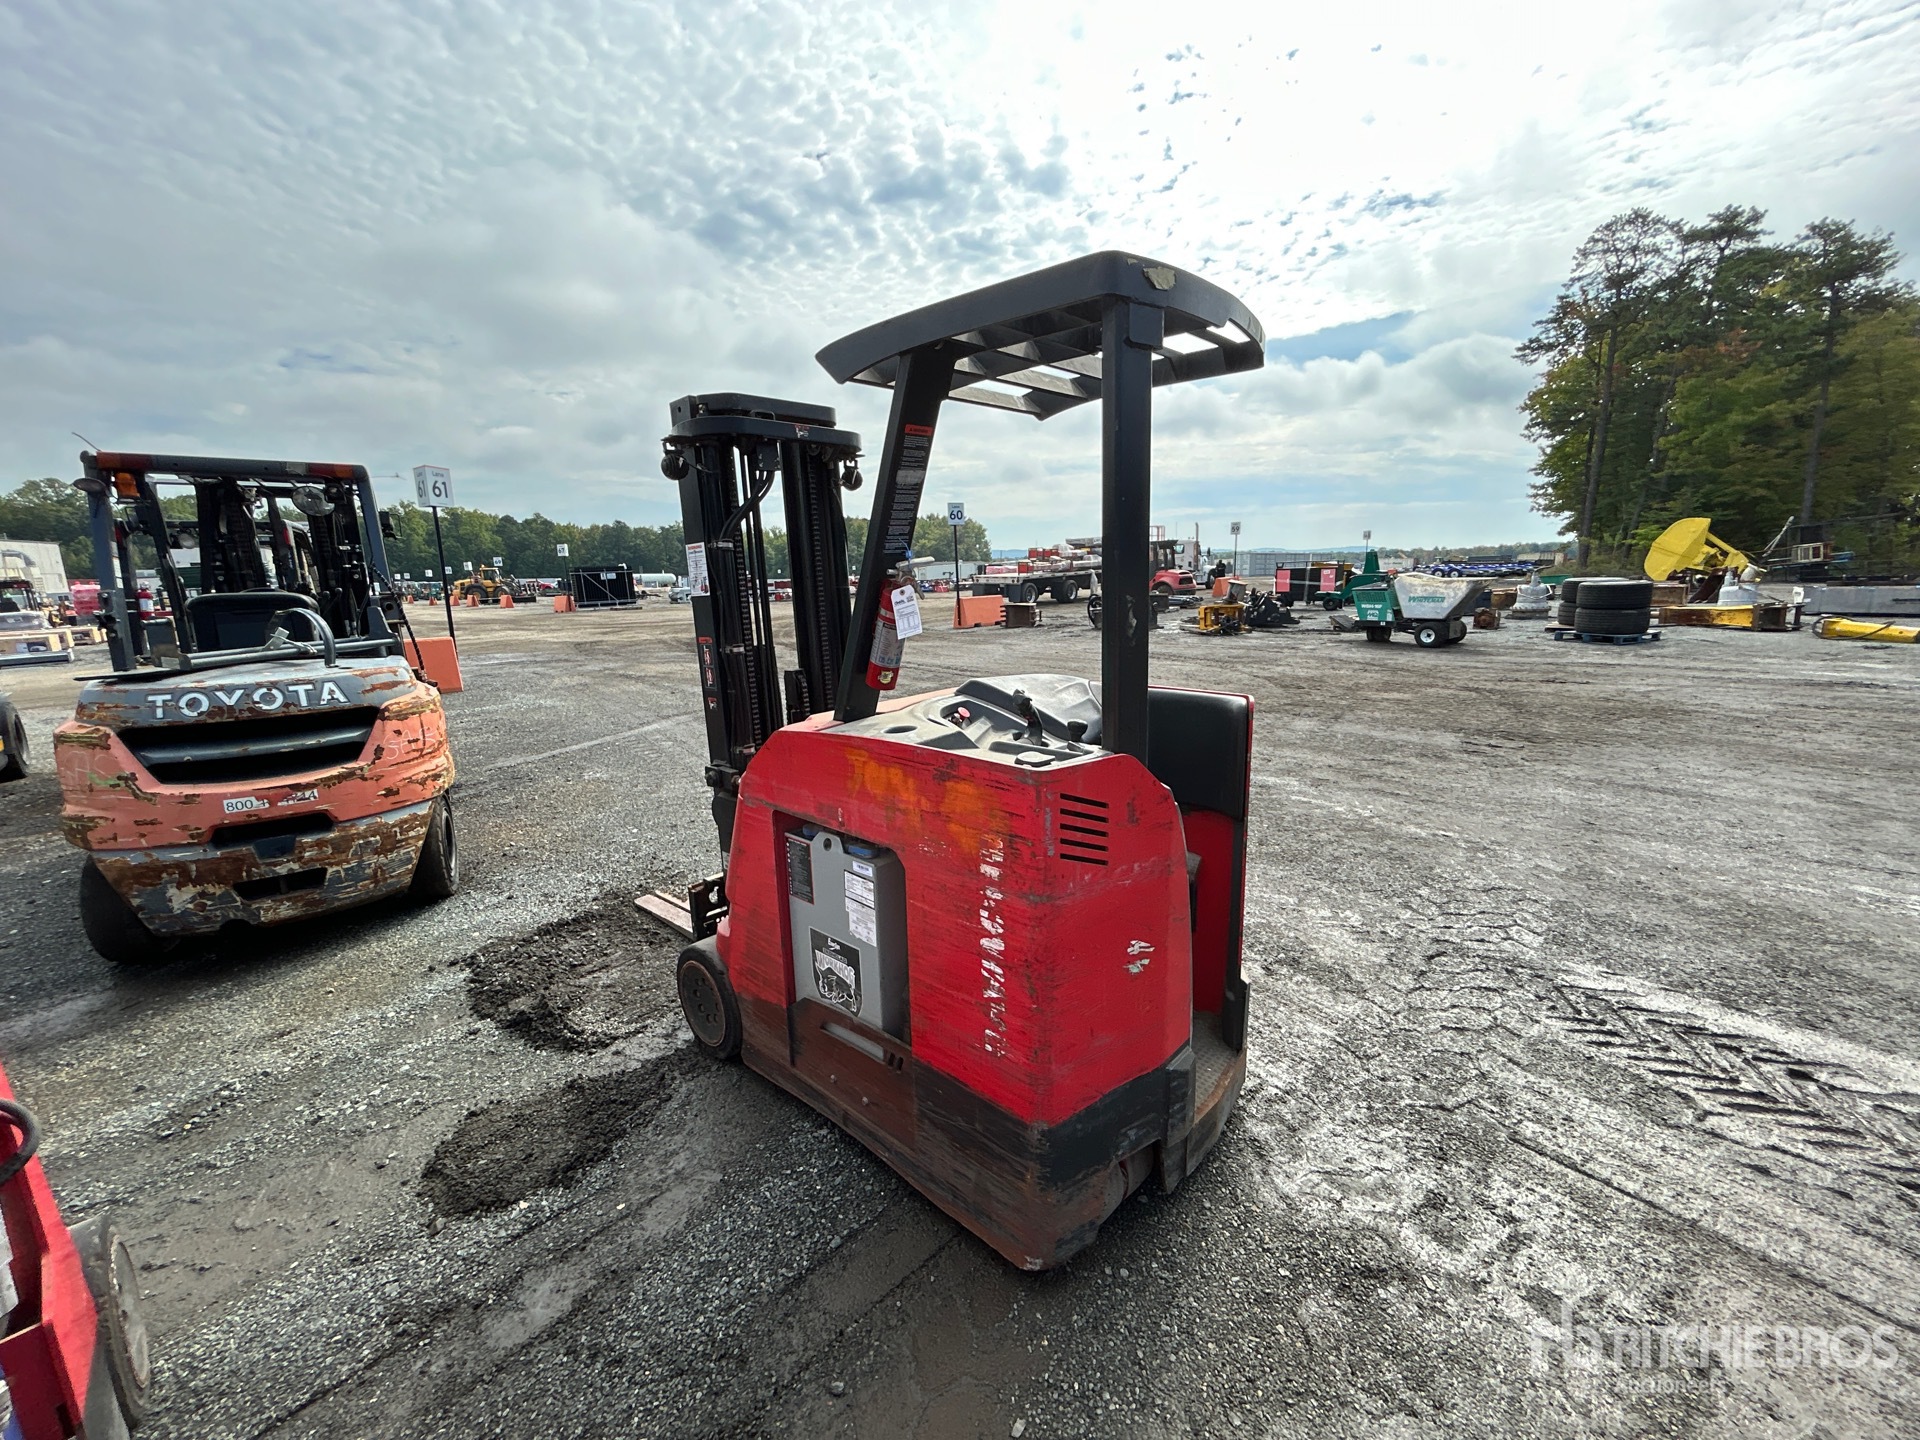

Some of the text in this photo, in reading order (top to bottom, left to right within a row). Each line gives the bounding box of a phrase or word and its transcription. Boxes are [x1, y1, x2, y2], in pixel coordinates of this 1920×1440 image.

[418, 480, 426, 498] 61
[432, 480, 449, 498] 61
[949, 510, 963, 520] 60
[1231, 525, 1240, 533] 59
[147, 682, 350, 719] TOYOTA
[815, 950, 856, 989] WORKHOG
